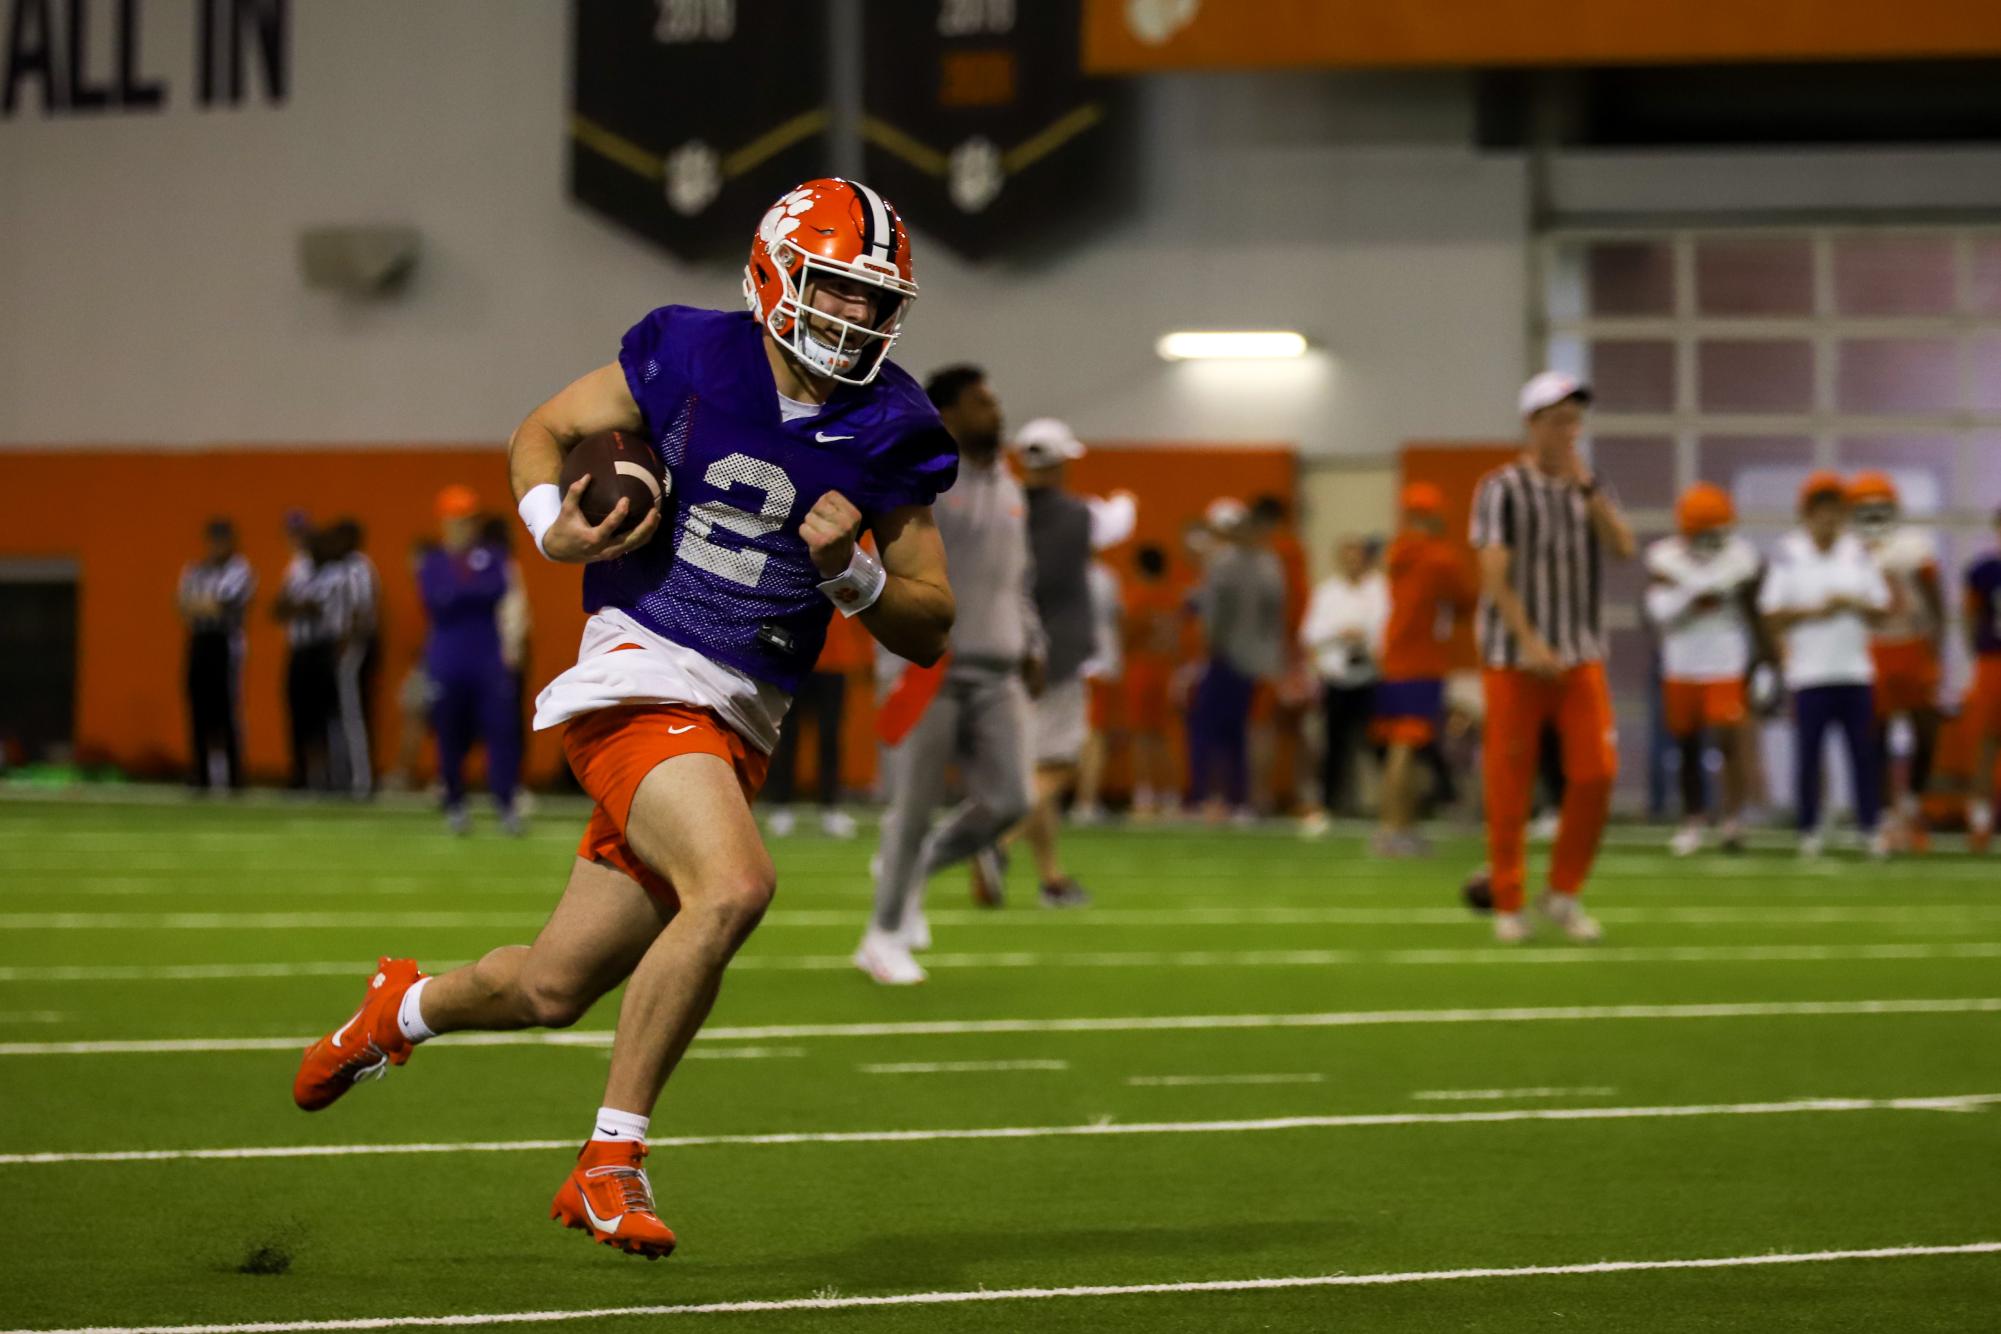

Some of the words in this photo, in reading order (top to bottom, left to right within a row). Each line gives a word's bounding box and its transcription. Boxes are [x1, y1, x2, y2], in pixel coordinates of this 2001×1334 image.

[1, 0, 167, 117] ALL
[197, 0, 290, 110] IN
[675, 452, 796, 588] 2
